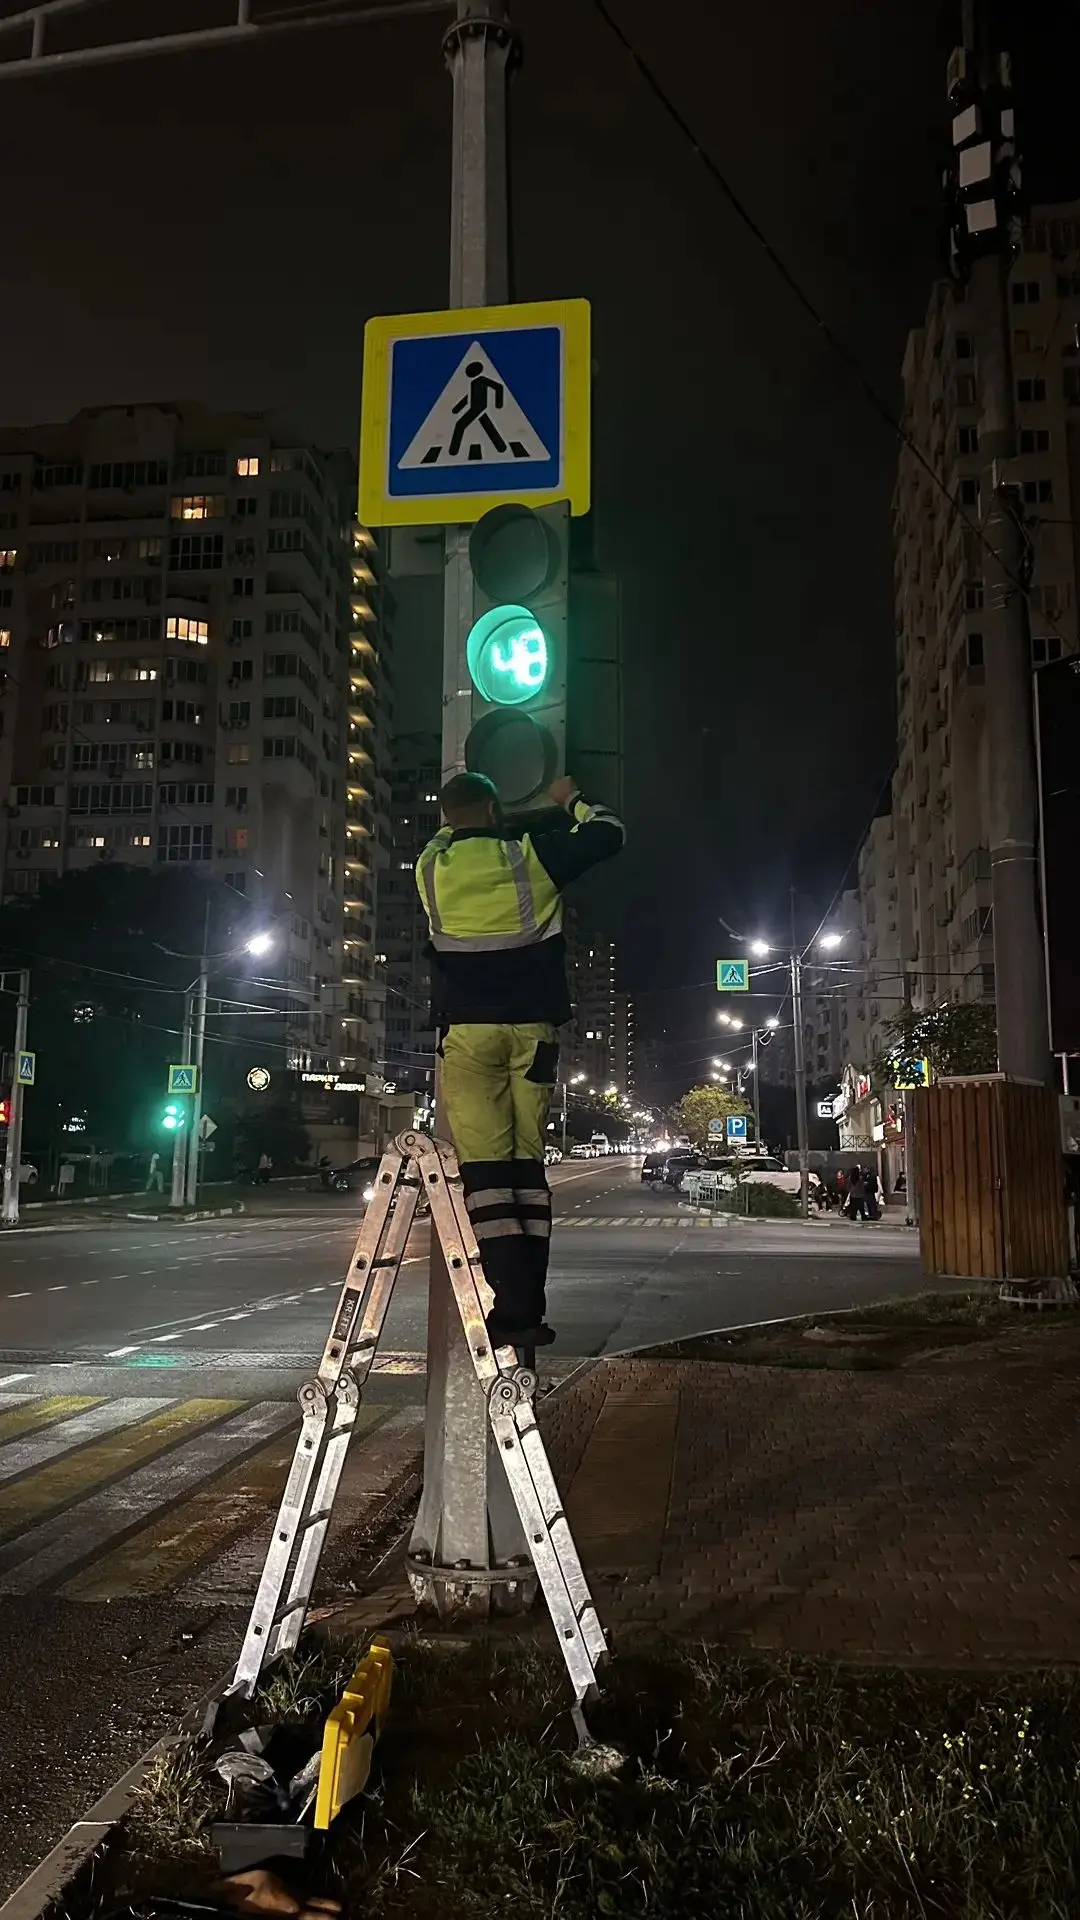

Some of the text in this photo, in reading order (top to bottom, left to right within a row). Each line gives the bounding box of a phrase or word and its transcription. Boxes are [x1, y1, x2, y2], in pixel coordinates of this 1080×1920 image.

[301, 1073, 340, 1083] ПАРКЕТ
[334, 1083, 366, 1092] ДВЕРИ
[732, 1118, 744, 1134] P
[340, 1299, 355, 1329] KRFT
